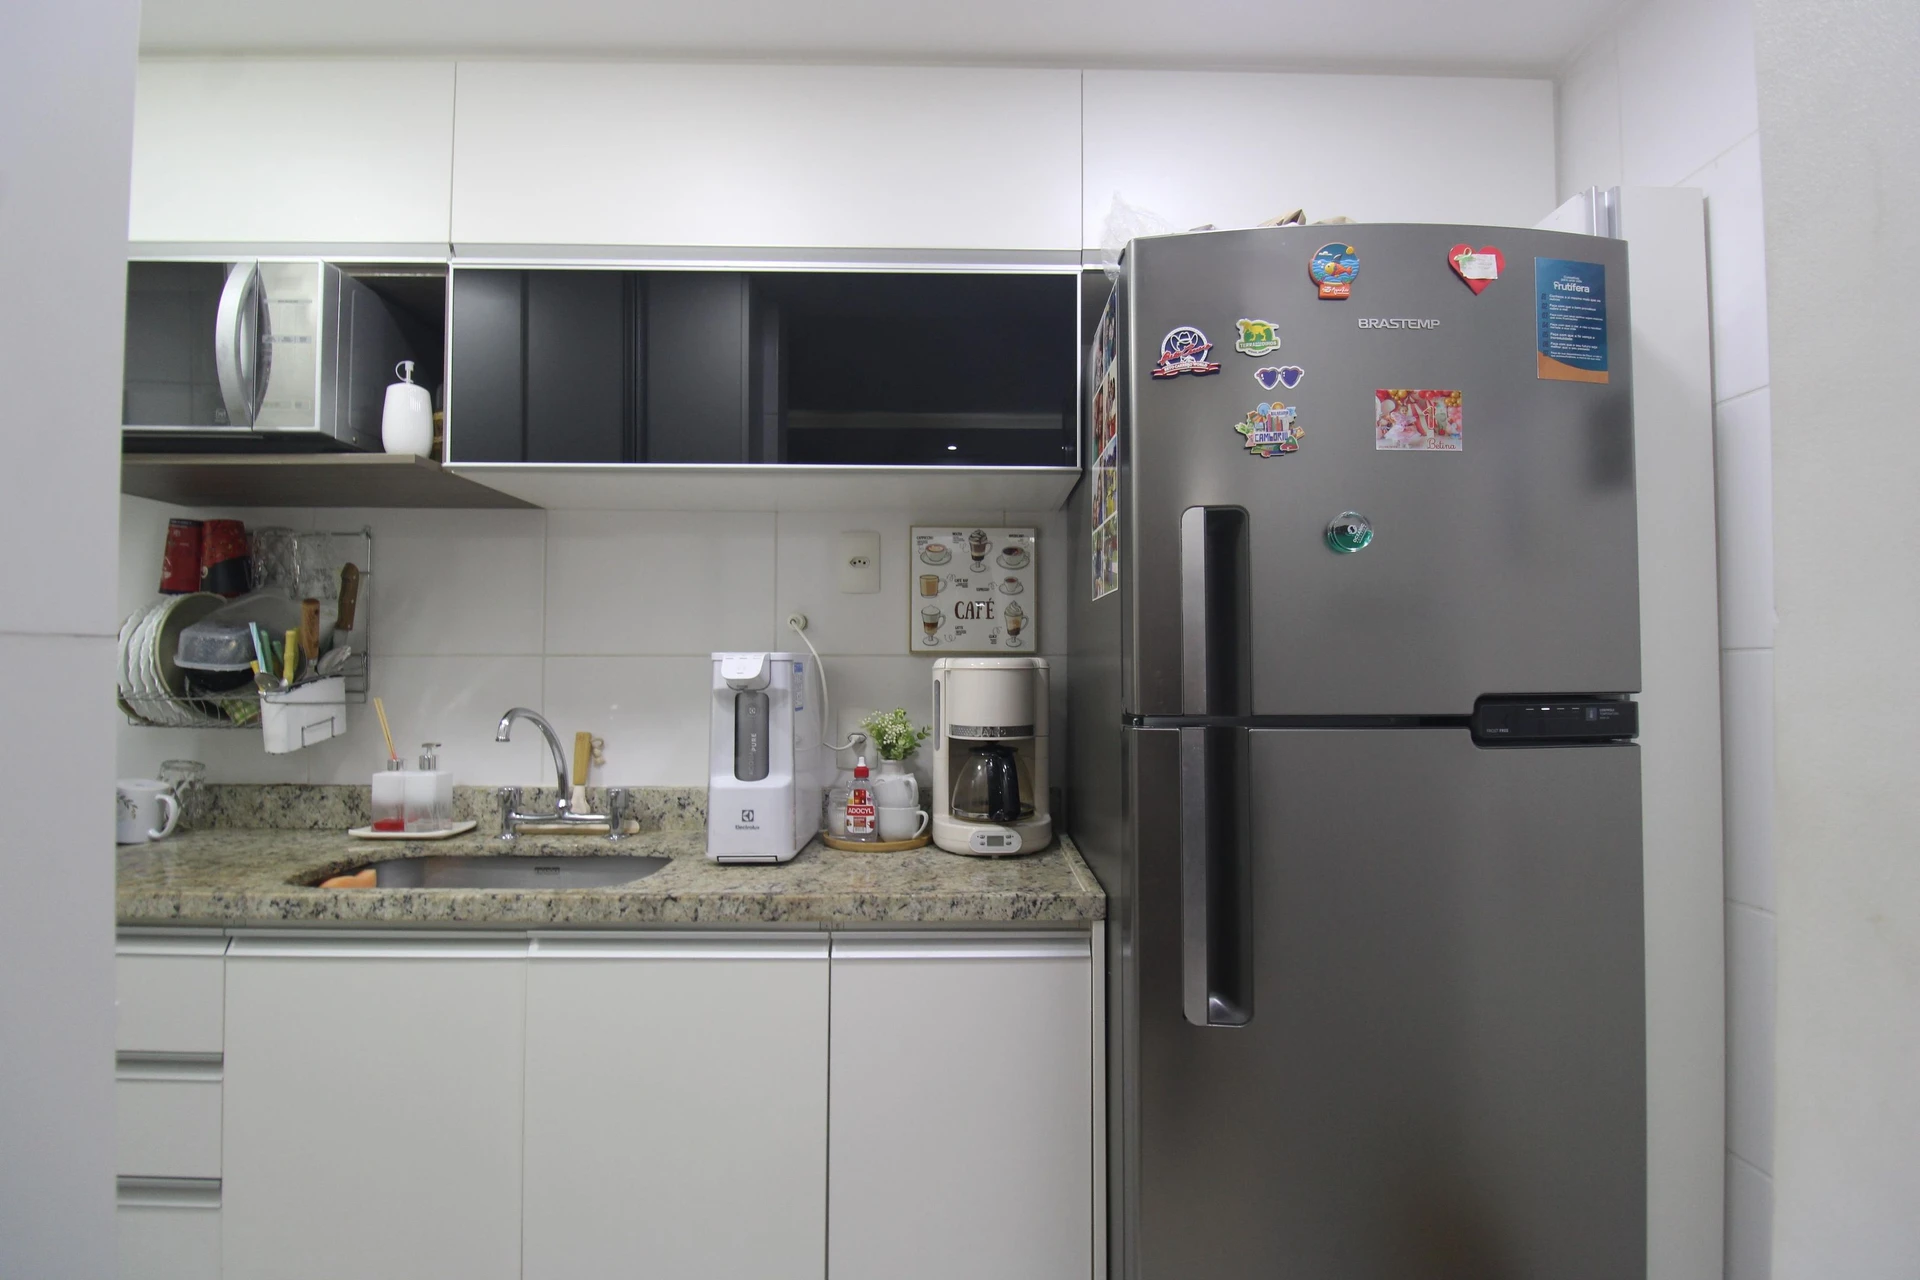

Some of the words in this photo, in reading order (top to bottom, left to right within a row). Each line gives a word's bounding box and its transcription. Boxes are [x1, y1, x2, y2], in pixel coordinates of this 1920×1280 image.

[1358, 318, 1440, 330] BRASTEMP
[1426, 438, 1456, 450] Betina
[954, 598, 995, 620] CAFÉ
[847, 807, 873, 815] ADOCYL
